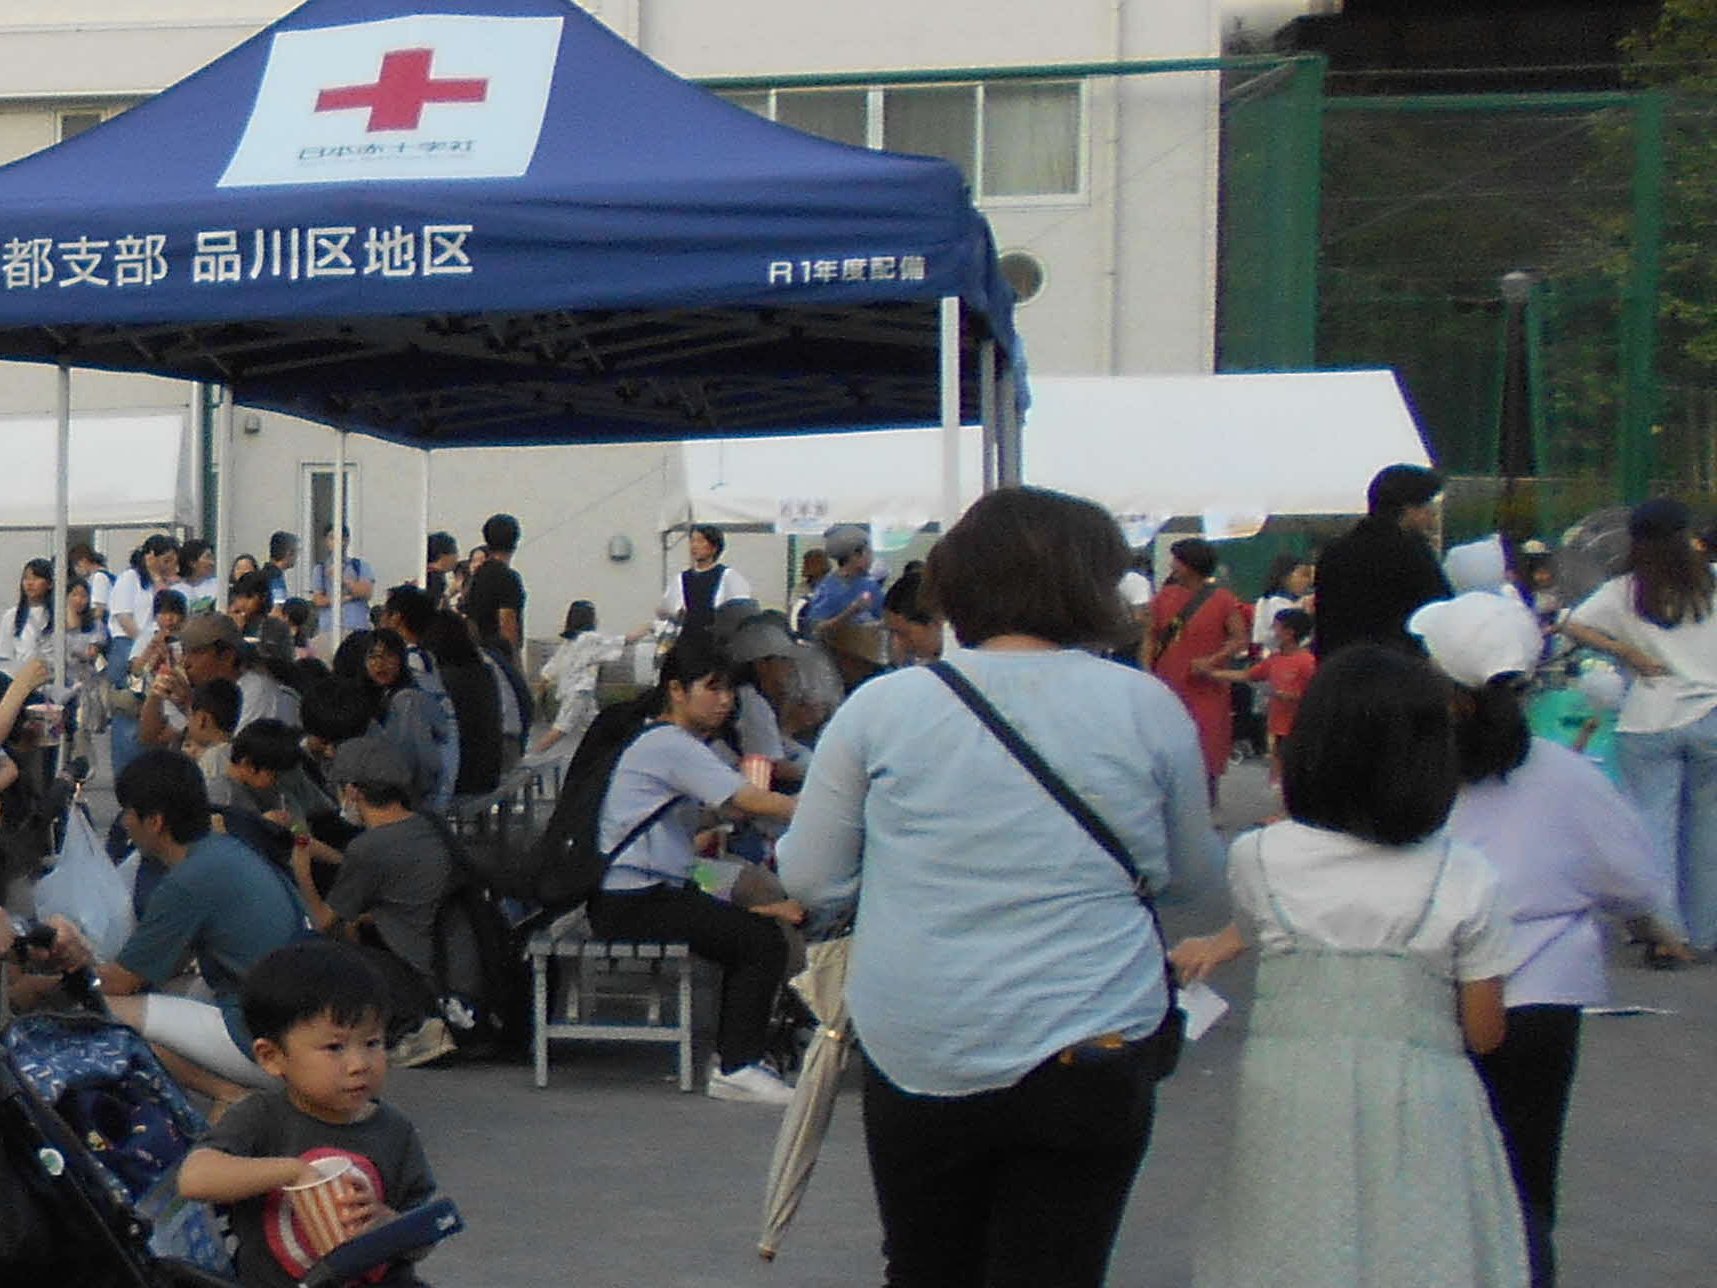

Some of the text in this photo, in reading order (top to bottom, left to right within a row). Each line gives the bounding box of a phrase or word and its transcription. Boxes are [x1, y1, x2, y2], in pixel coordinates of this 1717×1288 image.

[191, 224, 474, 283] 品川区地区
